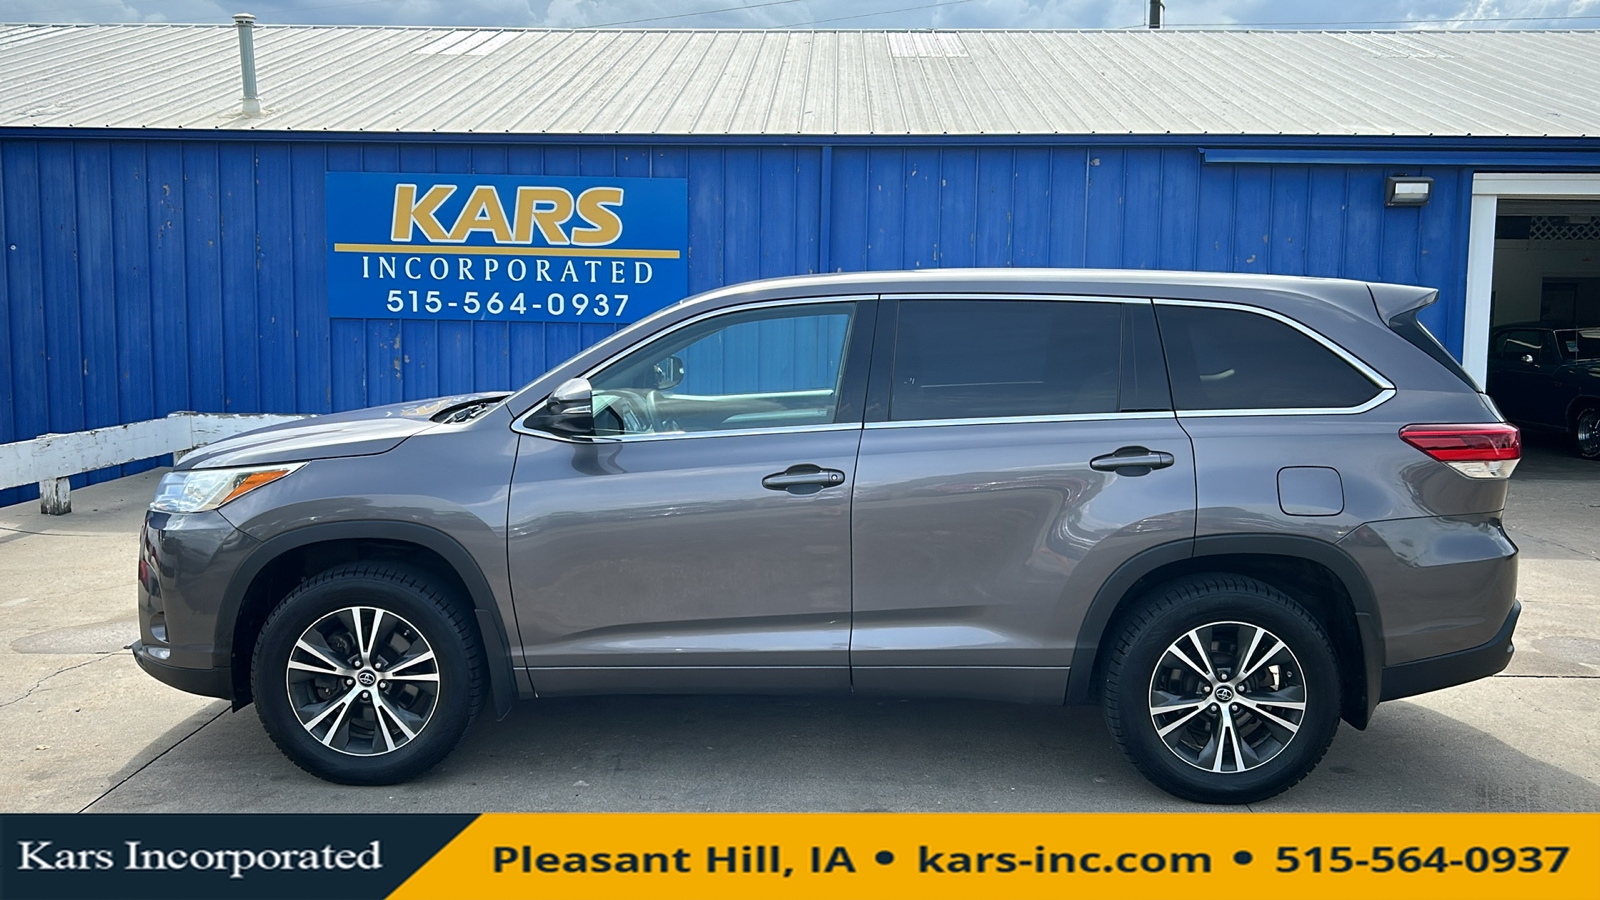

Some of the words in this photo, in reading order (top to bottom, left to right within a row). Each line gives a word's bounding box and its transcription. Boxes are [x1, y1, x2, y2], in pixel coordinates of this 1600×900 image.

[391, 184, 624, 246] KARS
[362, 256, 654, 284] INCORPORATED
[386, 290, 629, 317] 515-564-0937
